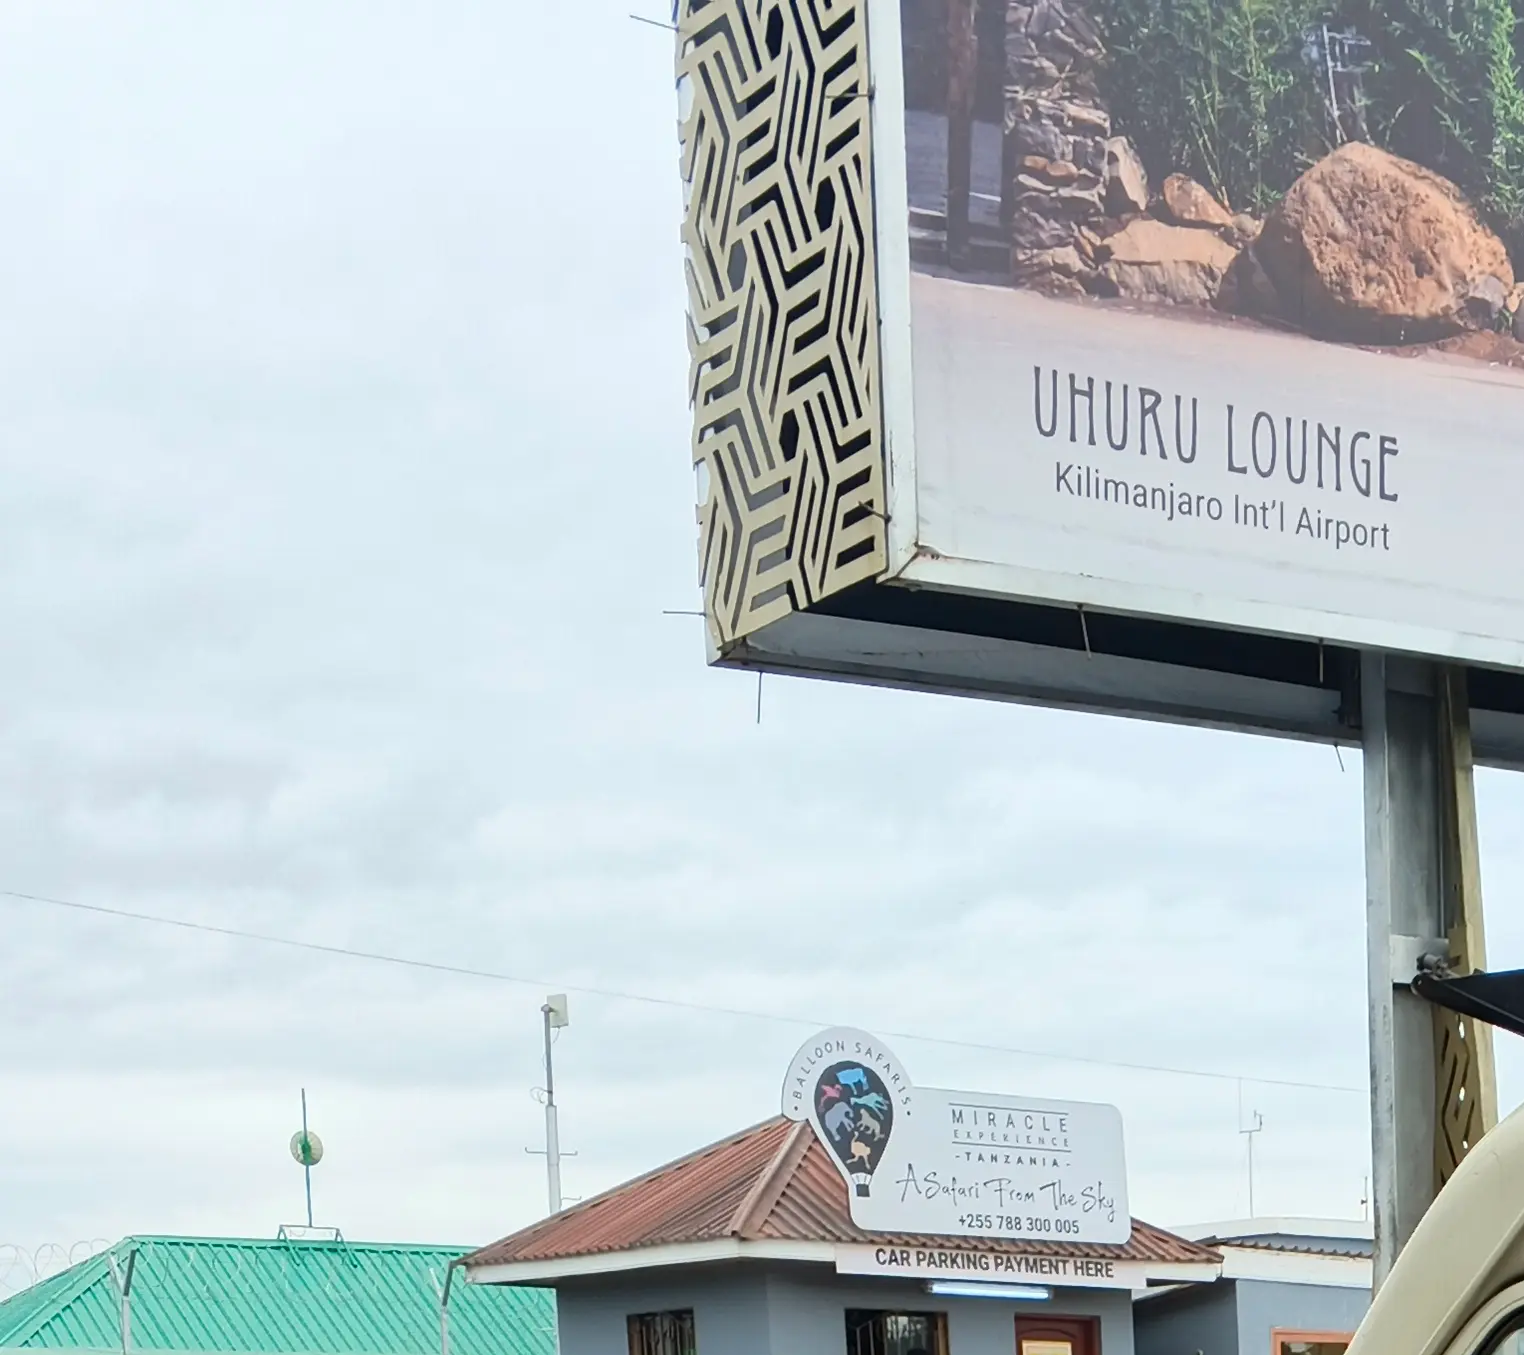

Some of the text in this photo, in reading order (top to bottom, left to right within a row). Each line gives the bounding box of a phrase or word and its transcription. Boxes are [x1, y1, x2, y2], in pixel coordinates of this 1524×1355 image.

[1032, 366, 1399, 502] UHURU LOUNGE
[1055, 461, 1391, 551] Kilimanjaro Int'l Airport
[792, 1040, 911, 1105] BALLOON SAFARIS
[951, 1108, 1068, 1134] MIRACLE
[953, 1129, 1070, 1147] EXPERIENCE
[923, 1171, 980, 1207] Safari
[983, 1177, 1036, 1203] From
[1039, 1179, 1078, 1211] The
[1080, 1181, 1115, 1223] Sky
[958, 1213, 1080, 1235] +255 788 300 005
[875, 1248, 1115, 1279] CAR PARKING PAYMENT HERE
